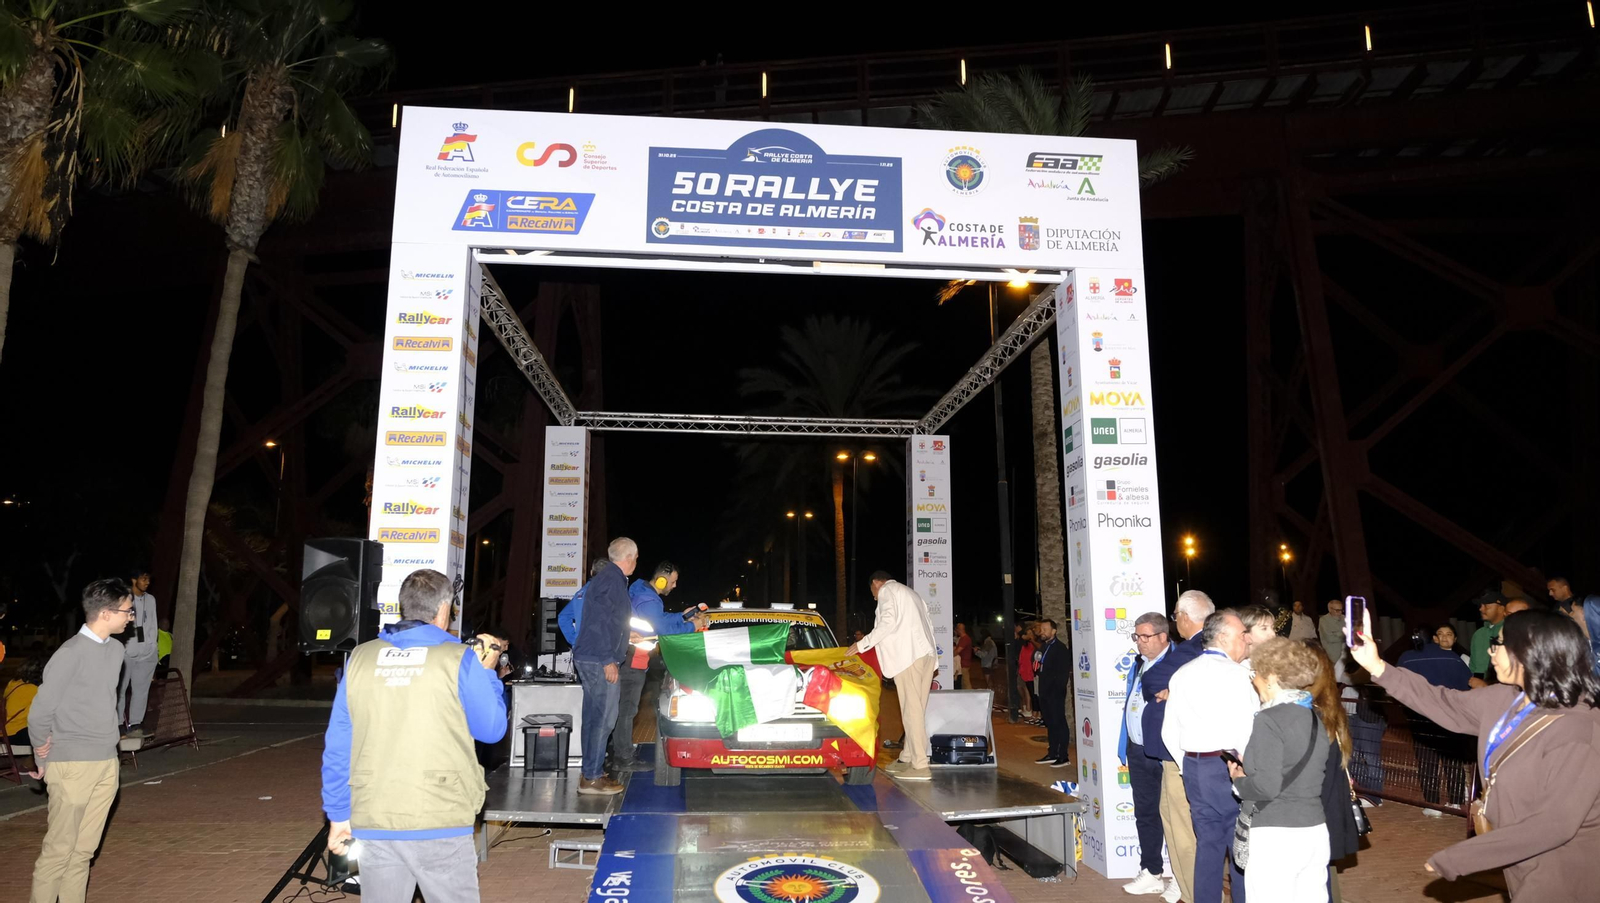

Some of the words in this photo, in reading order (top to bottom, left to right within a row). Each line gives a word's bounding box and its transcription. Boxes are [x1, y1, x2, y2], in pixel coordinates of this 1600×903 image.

[466, 166, 489, 174] Española
[671, 171, 721, 196] 50
[724, 173, 879, 202] RALLYE
[1027, 178, 1071, 191] Andalucía
[506, 195, 577, 211] CERA
[671, 199, 742, 215] COSTA
[745, 203, 775, 216] DE
[779, 203, 876, 220] ALMERÍA
[519, 217, 563, 230] Recalvi
[949, 222, 987, 233] COSTA
[989, 224, 1004, 234] DE
[1046, 227, 1121, 240] DIPUTACIÓN
[937, 233, 1006, 249] ALMERÍA
[1046, 239, 1063, 250] DE
[1065, 239, 1119, 252] ALMERÍA
[398, 312, 452, 325] Rallycar
[404, 339, 441, 349] Recalvi
[1089, 391, 1145, 406] MOYA
[391, 406, 446, 419] Rallycar
[1093, 427, 1115, 435] UNED
[397, 433, 435, 443] Recalvi
[1093, 453, 1148, 469] gasolia
[383, 502, 440, 515] Rallycar
[916, 503, 946, 512] MOYA
[1097, 512, 1152, 528] Phonika
[389, 530, 428, 540] Recalvi
[917, 536, 947, 546] gasolia
[917, 569, 948, 579] Phonika
[711, 755, 823, 765] AUTOCOSMI.COM
[725, 858, 818, 881] AUTOMOVIL
[827, 862, 866, 880] CLUB
